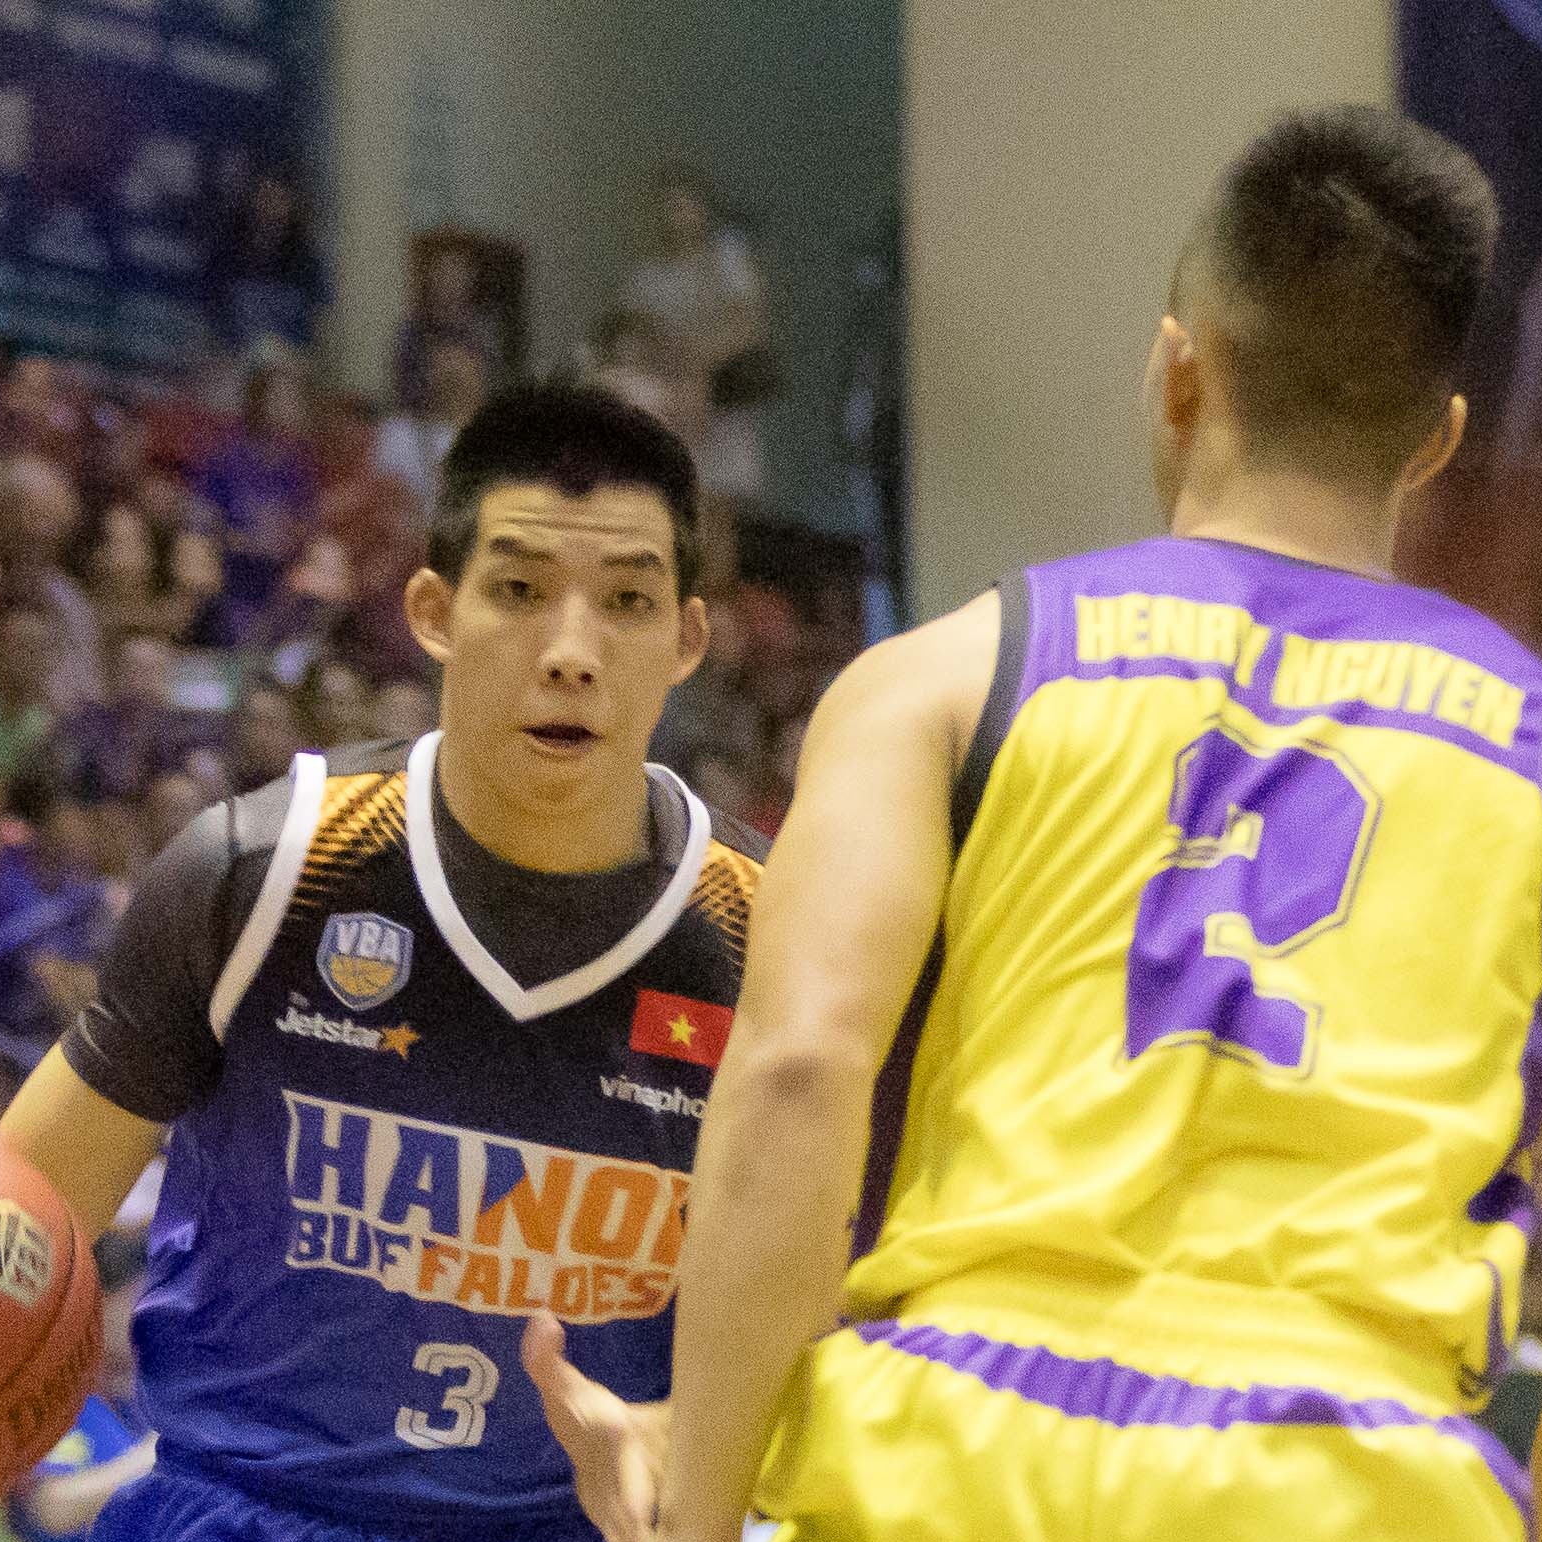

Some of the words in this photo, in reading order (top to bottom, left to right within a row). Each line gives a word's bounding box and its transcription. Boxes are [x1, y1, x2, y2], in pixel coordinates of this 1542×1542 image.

[1074, 593, 1270, 687] HENRY
[1272, 635, 1525, 748] NGUYEN
[337, 920, 401, 963] VBA
[1122, 718, 1383, 1078] 2
[275, 1006, 383, 1052] Jetstar
[287, 1209, 675, 1325] BUFFALOES
[395, 1342, 499, 1450] 3
